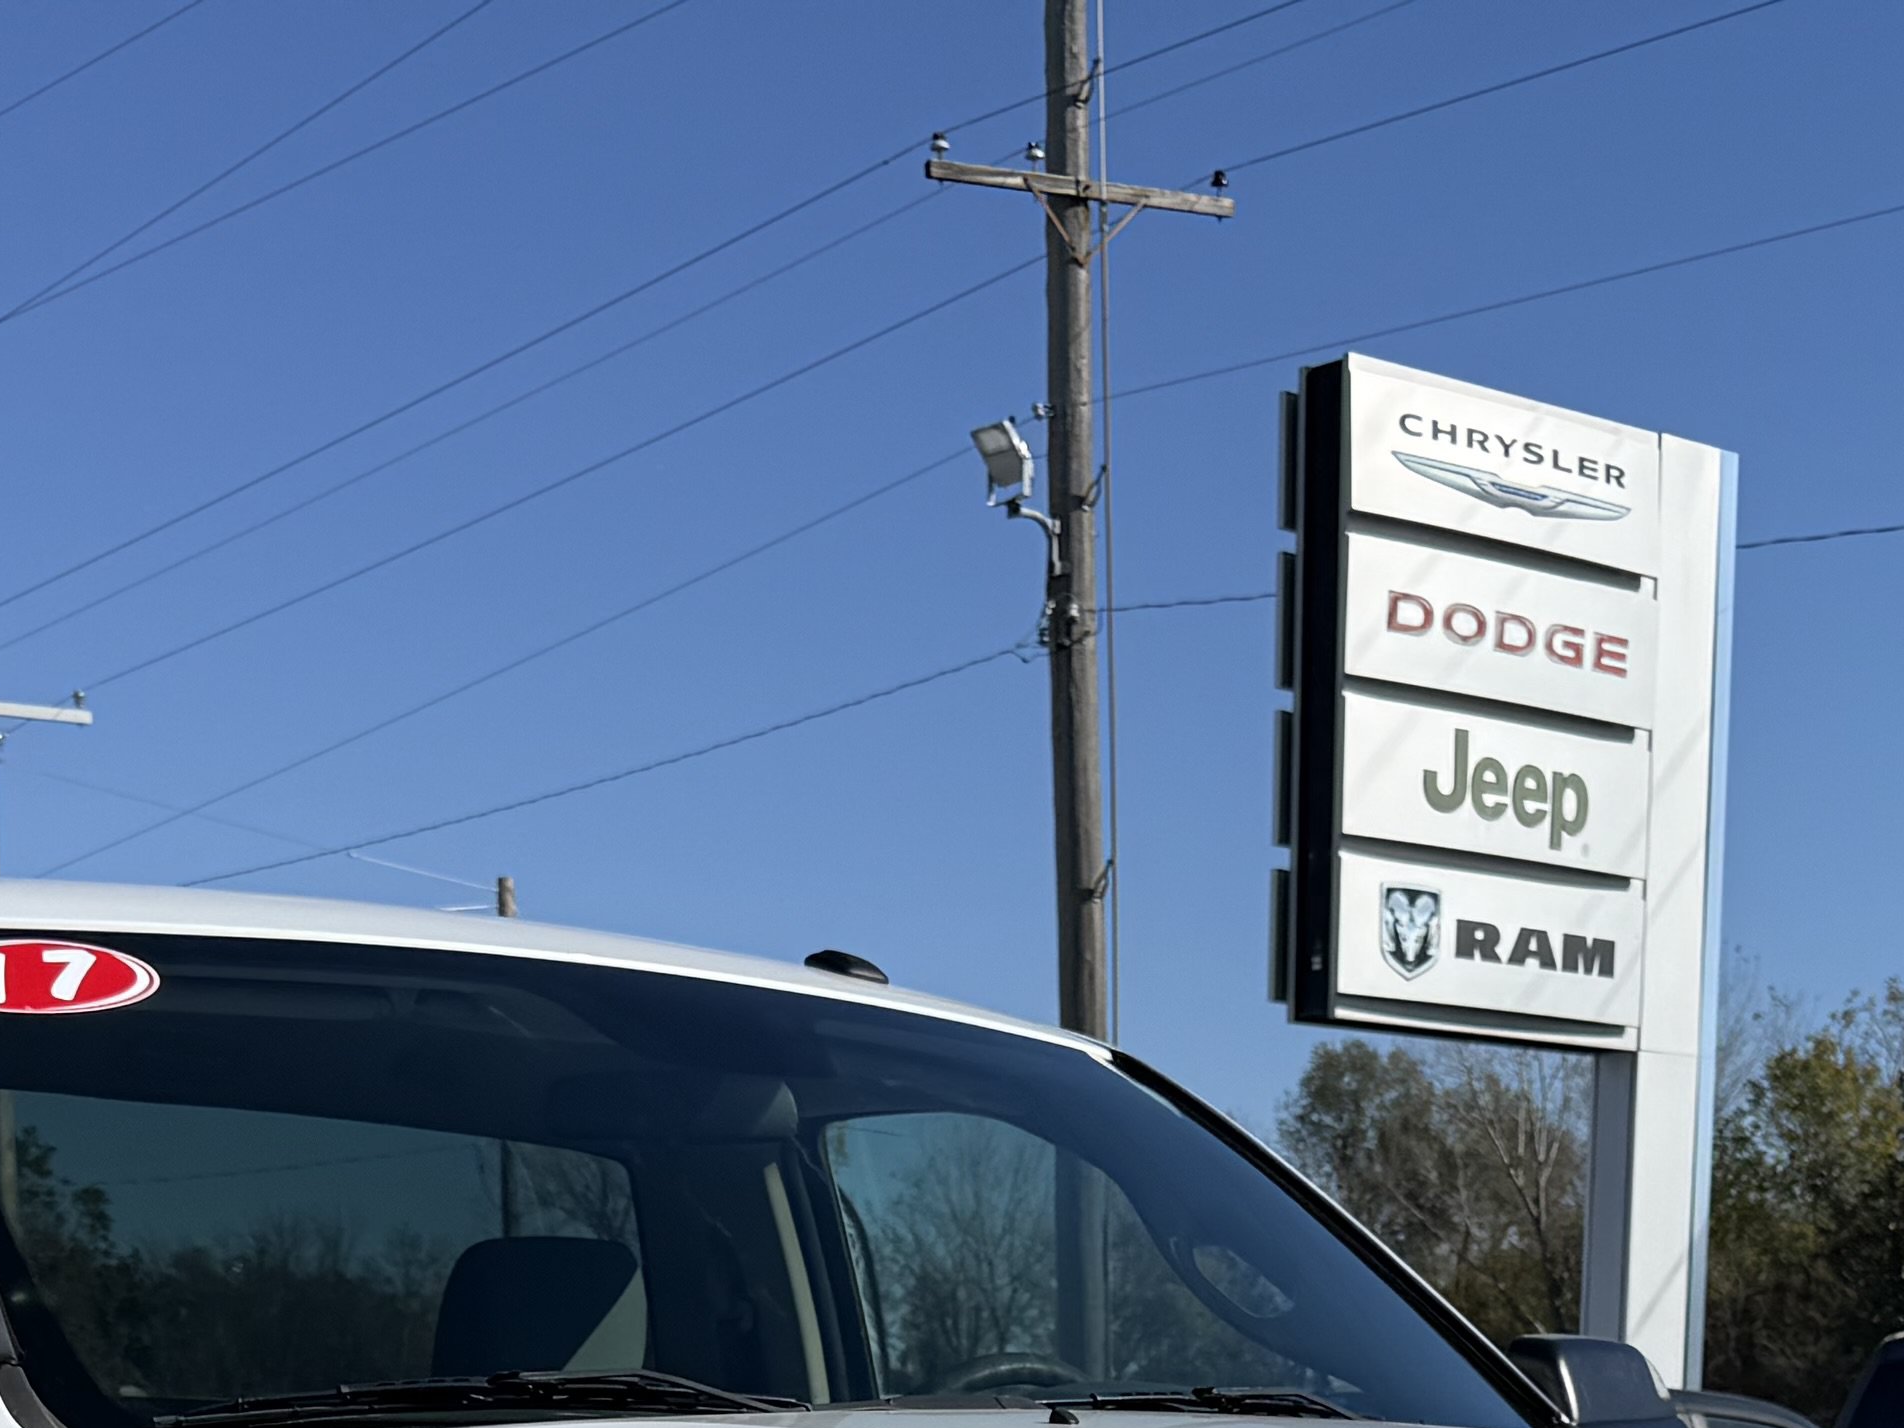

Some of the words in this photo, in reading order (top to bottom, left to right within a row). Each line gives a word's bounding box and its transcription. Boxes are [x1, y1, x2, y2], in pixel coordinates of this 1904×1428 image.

[1398, 413, 1626, 489] CHRYSLER
[1386, 590, 1629, 678] DODGE
[1422, 729, 1589, 851] Jeep
[1455, 918, 1615, 979] RAM
